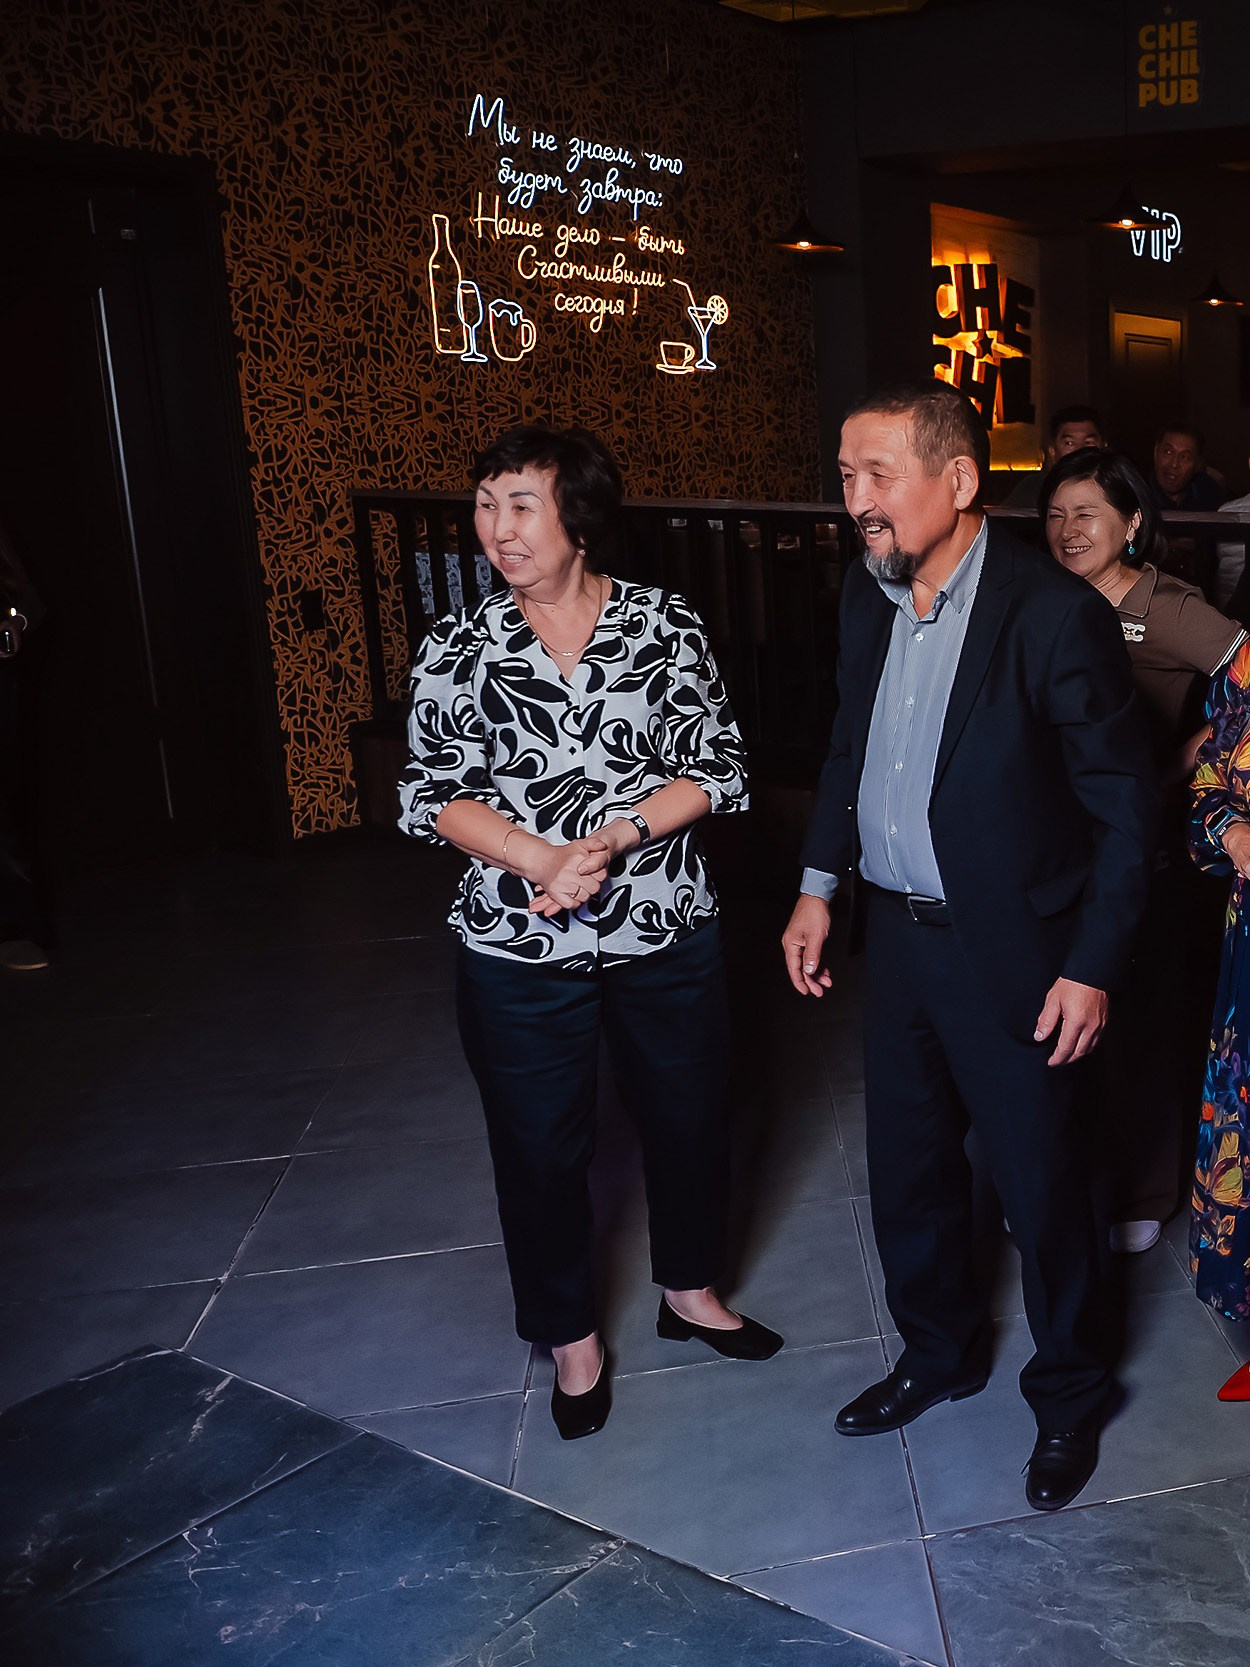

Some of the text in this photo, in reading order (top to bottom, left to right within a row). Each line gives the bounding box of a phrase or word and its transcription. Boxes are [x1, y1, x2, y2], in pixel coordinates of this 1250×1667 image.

[1138, 20, 1198, 50] CHE
[1138, 78, 1199, 108] PUB
[467, 93, 684, 175] Мы не знаем, что
[497, 157, 568, 209] будет
[473, 191, 544, 240] Наше
[554, 224, 601, 259] дело
[637, 225, 686, 256] быть
[1130, 205, 1181, 262] VIP
[517, 244, 666, 288] Счастливыми
